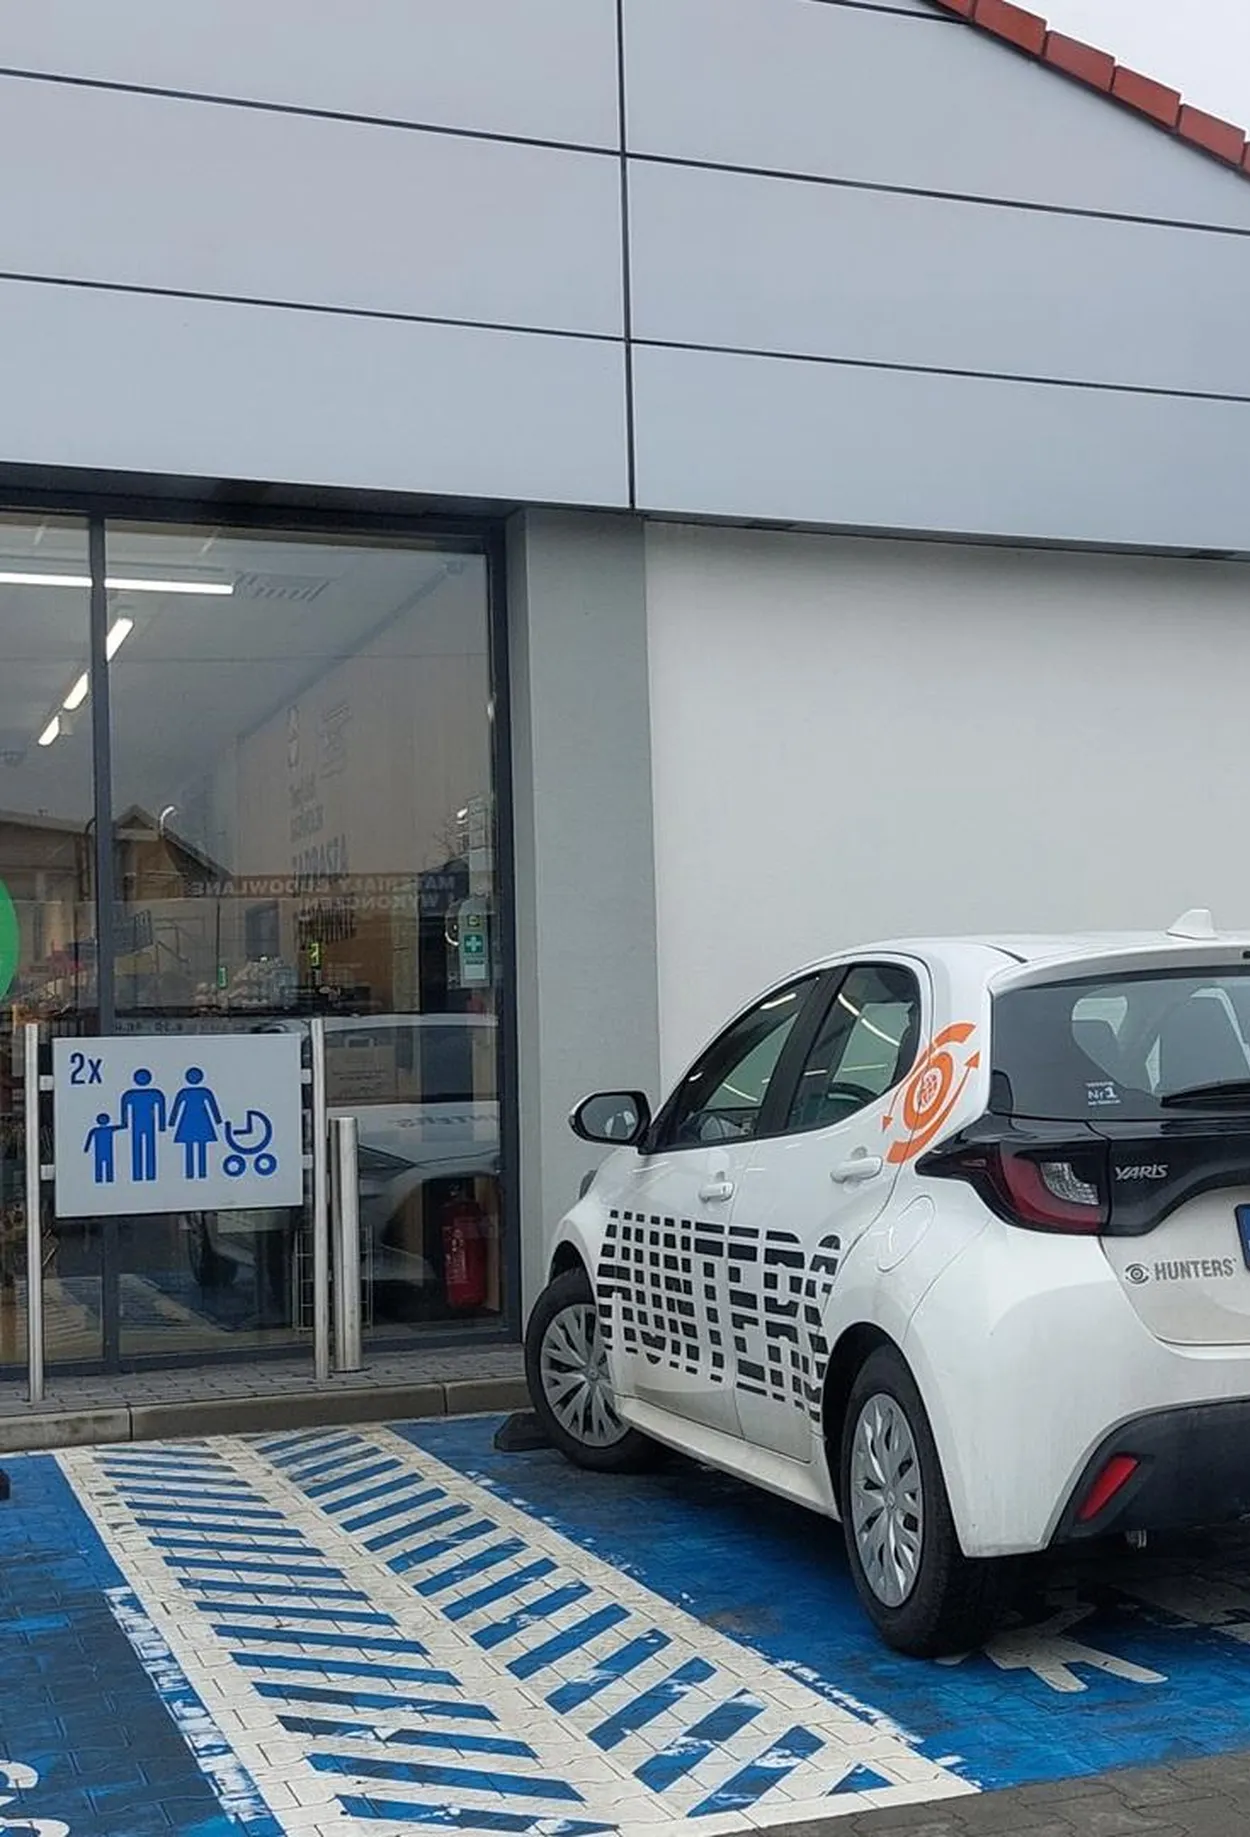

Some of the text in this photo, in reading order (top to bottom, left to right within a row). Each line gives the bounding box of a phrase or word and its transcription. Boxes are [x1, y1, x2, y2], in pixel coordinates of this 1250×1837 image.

[70, 1052, 102, 1084] 2x
[1115, 1164, 1168, 1180] YARIS
[1153, 1258, 1234, 1281] HUNTERS
